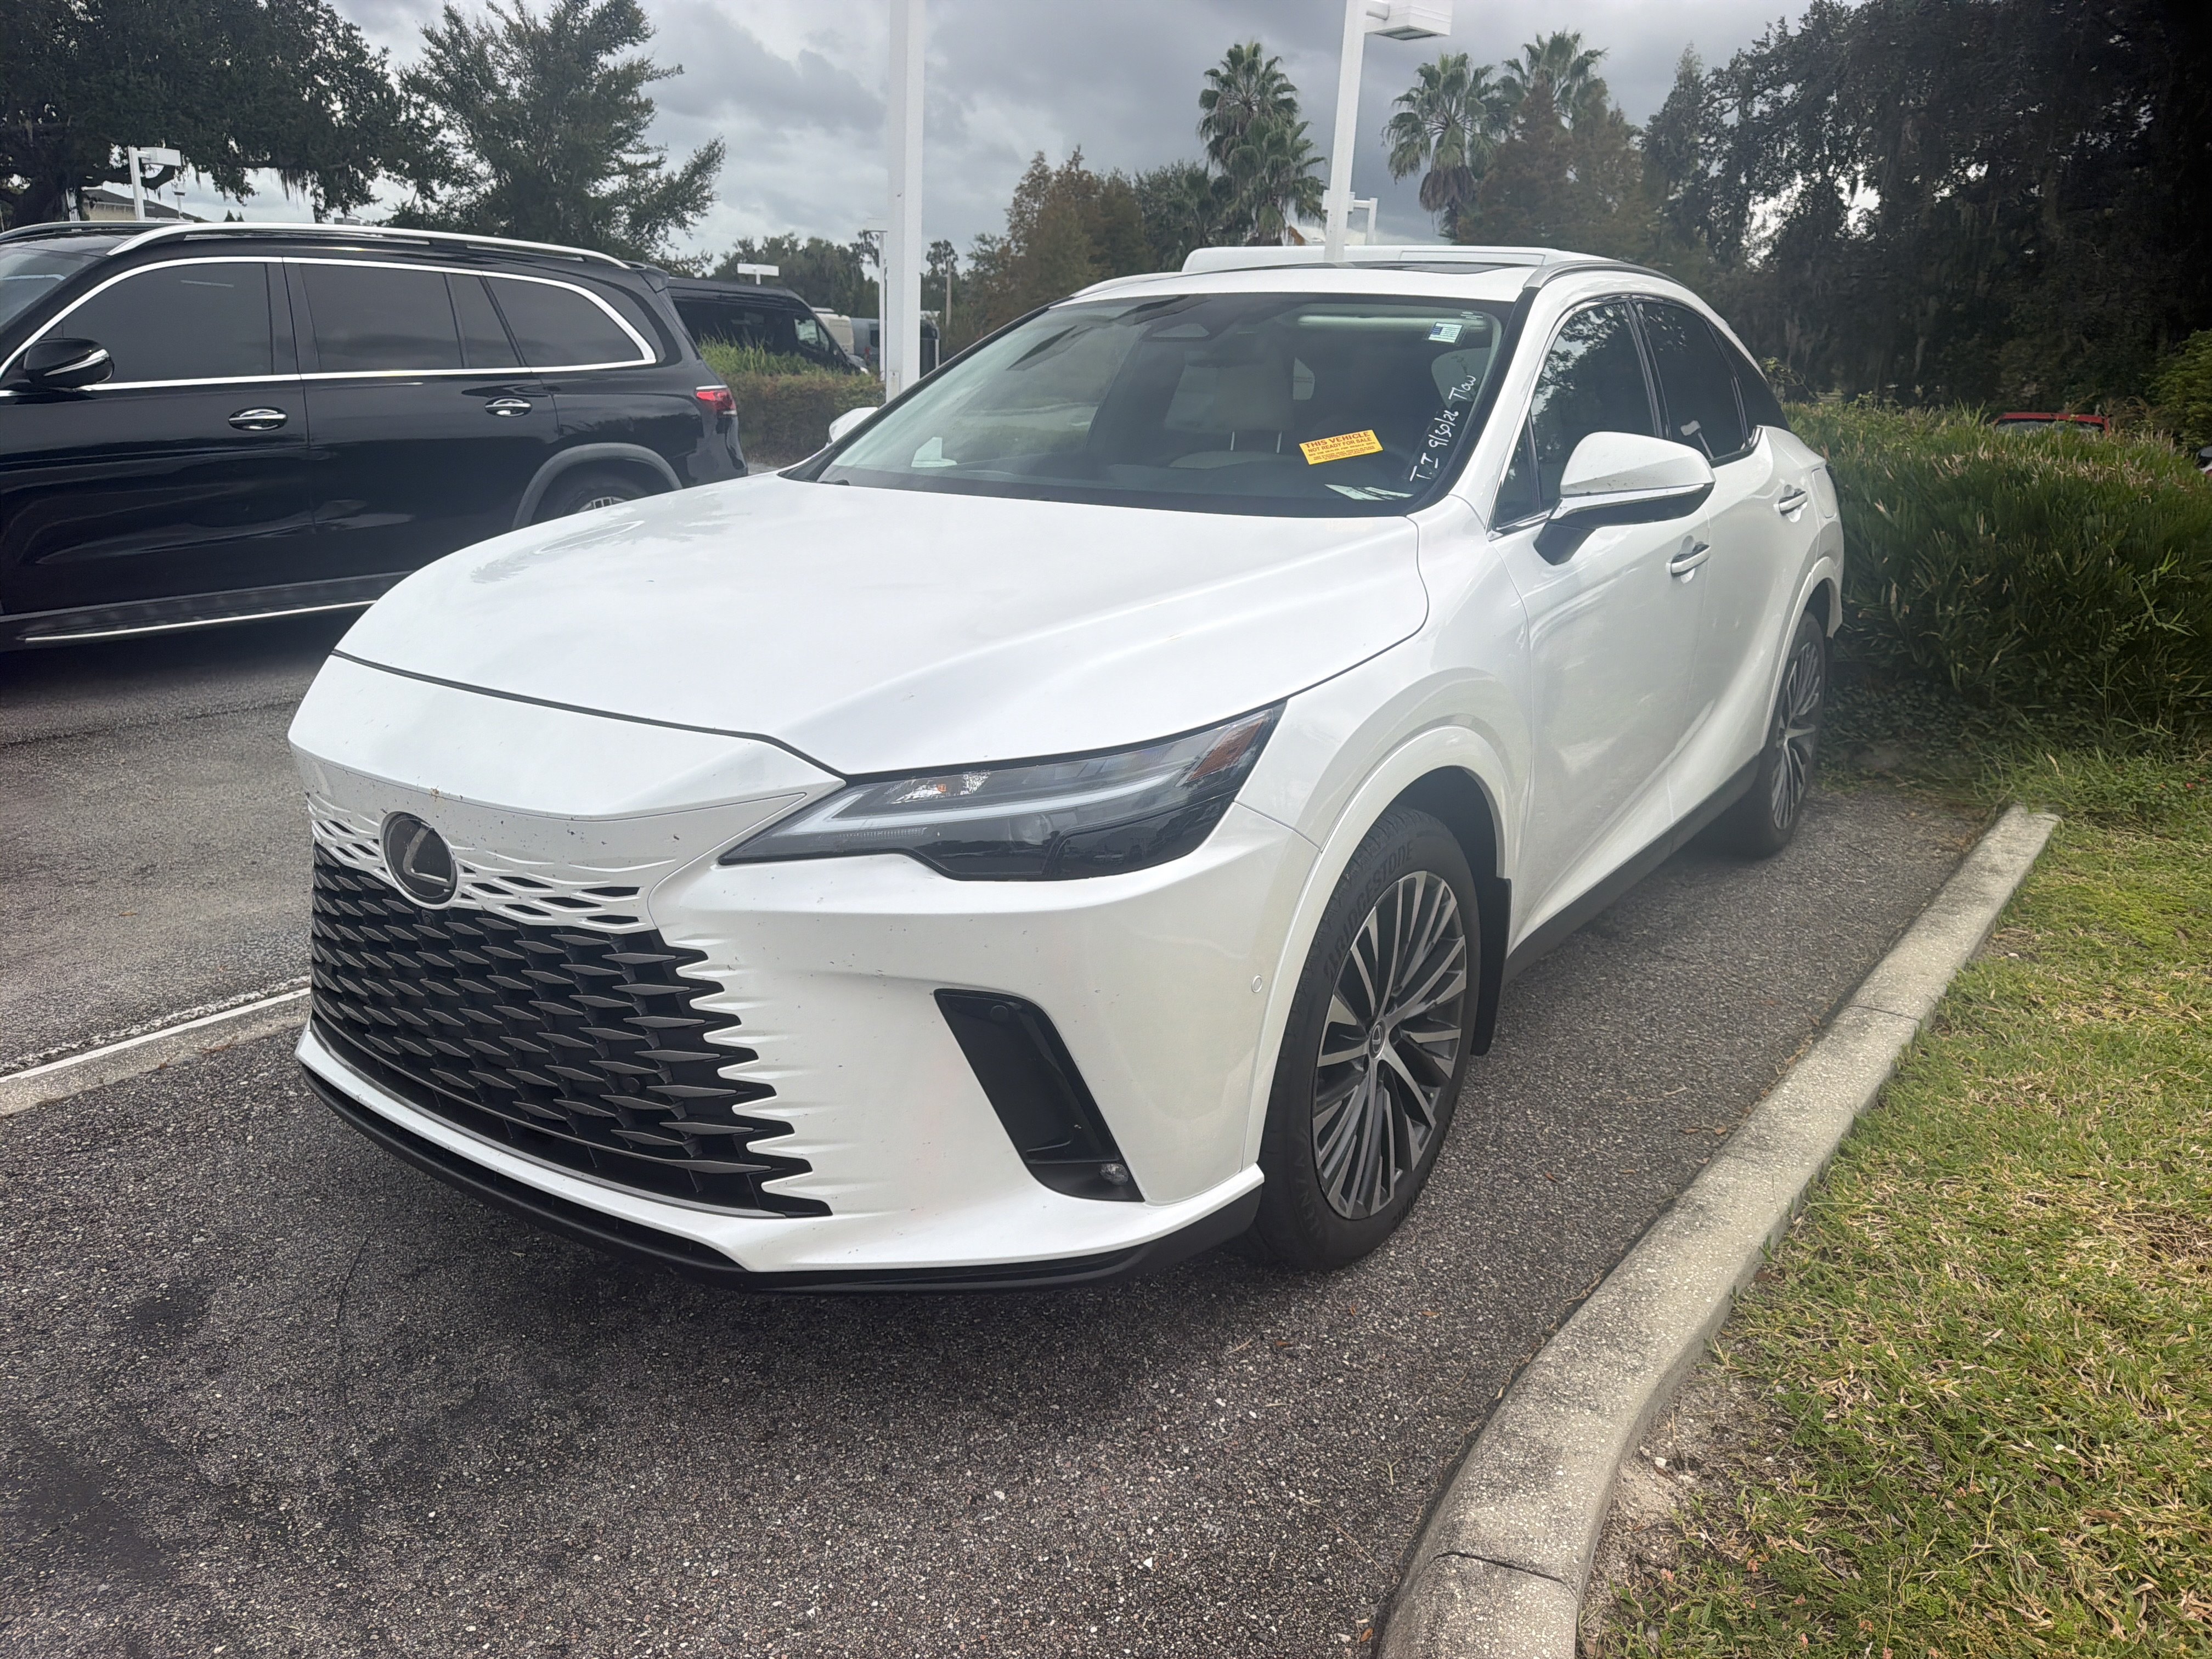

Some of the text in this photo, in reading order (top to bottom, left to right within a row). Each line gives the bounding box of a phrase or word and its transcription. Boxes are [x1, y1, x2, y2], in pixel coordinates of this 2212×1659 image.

[1305, 431, 1370, 448] THIS VEHICLE
[1321, 442, 1342, 450] READY
